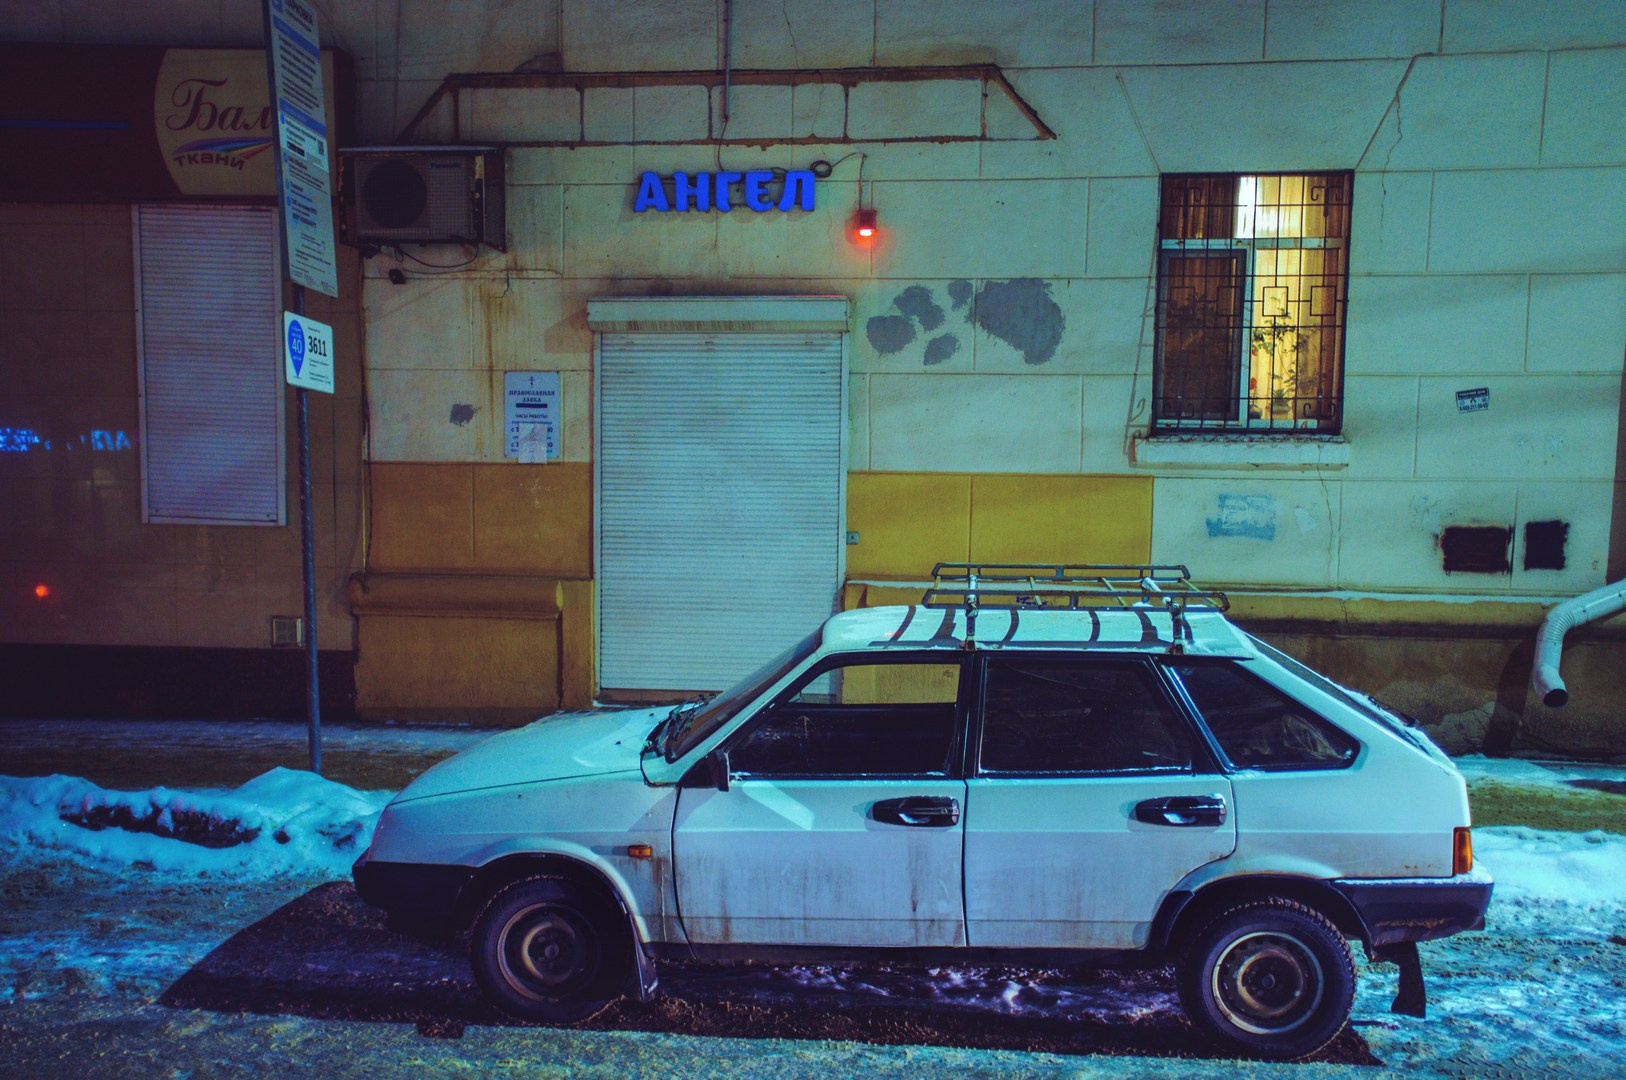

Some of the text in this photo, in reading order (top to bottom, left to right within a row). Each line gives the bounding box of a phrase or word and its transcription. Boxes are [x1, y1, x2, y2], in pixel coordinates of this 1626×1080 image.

[165, 78, 273, 131] Бал
[174, 151, 246, 172] ткани
[633, 169, 815, 212] АНГЕЛ
[292, 335, 327, 357] 40 3611
